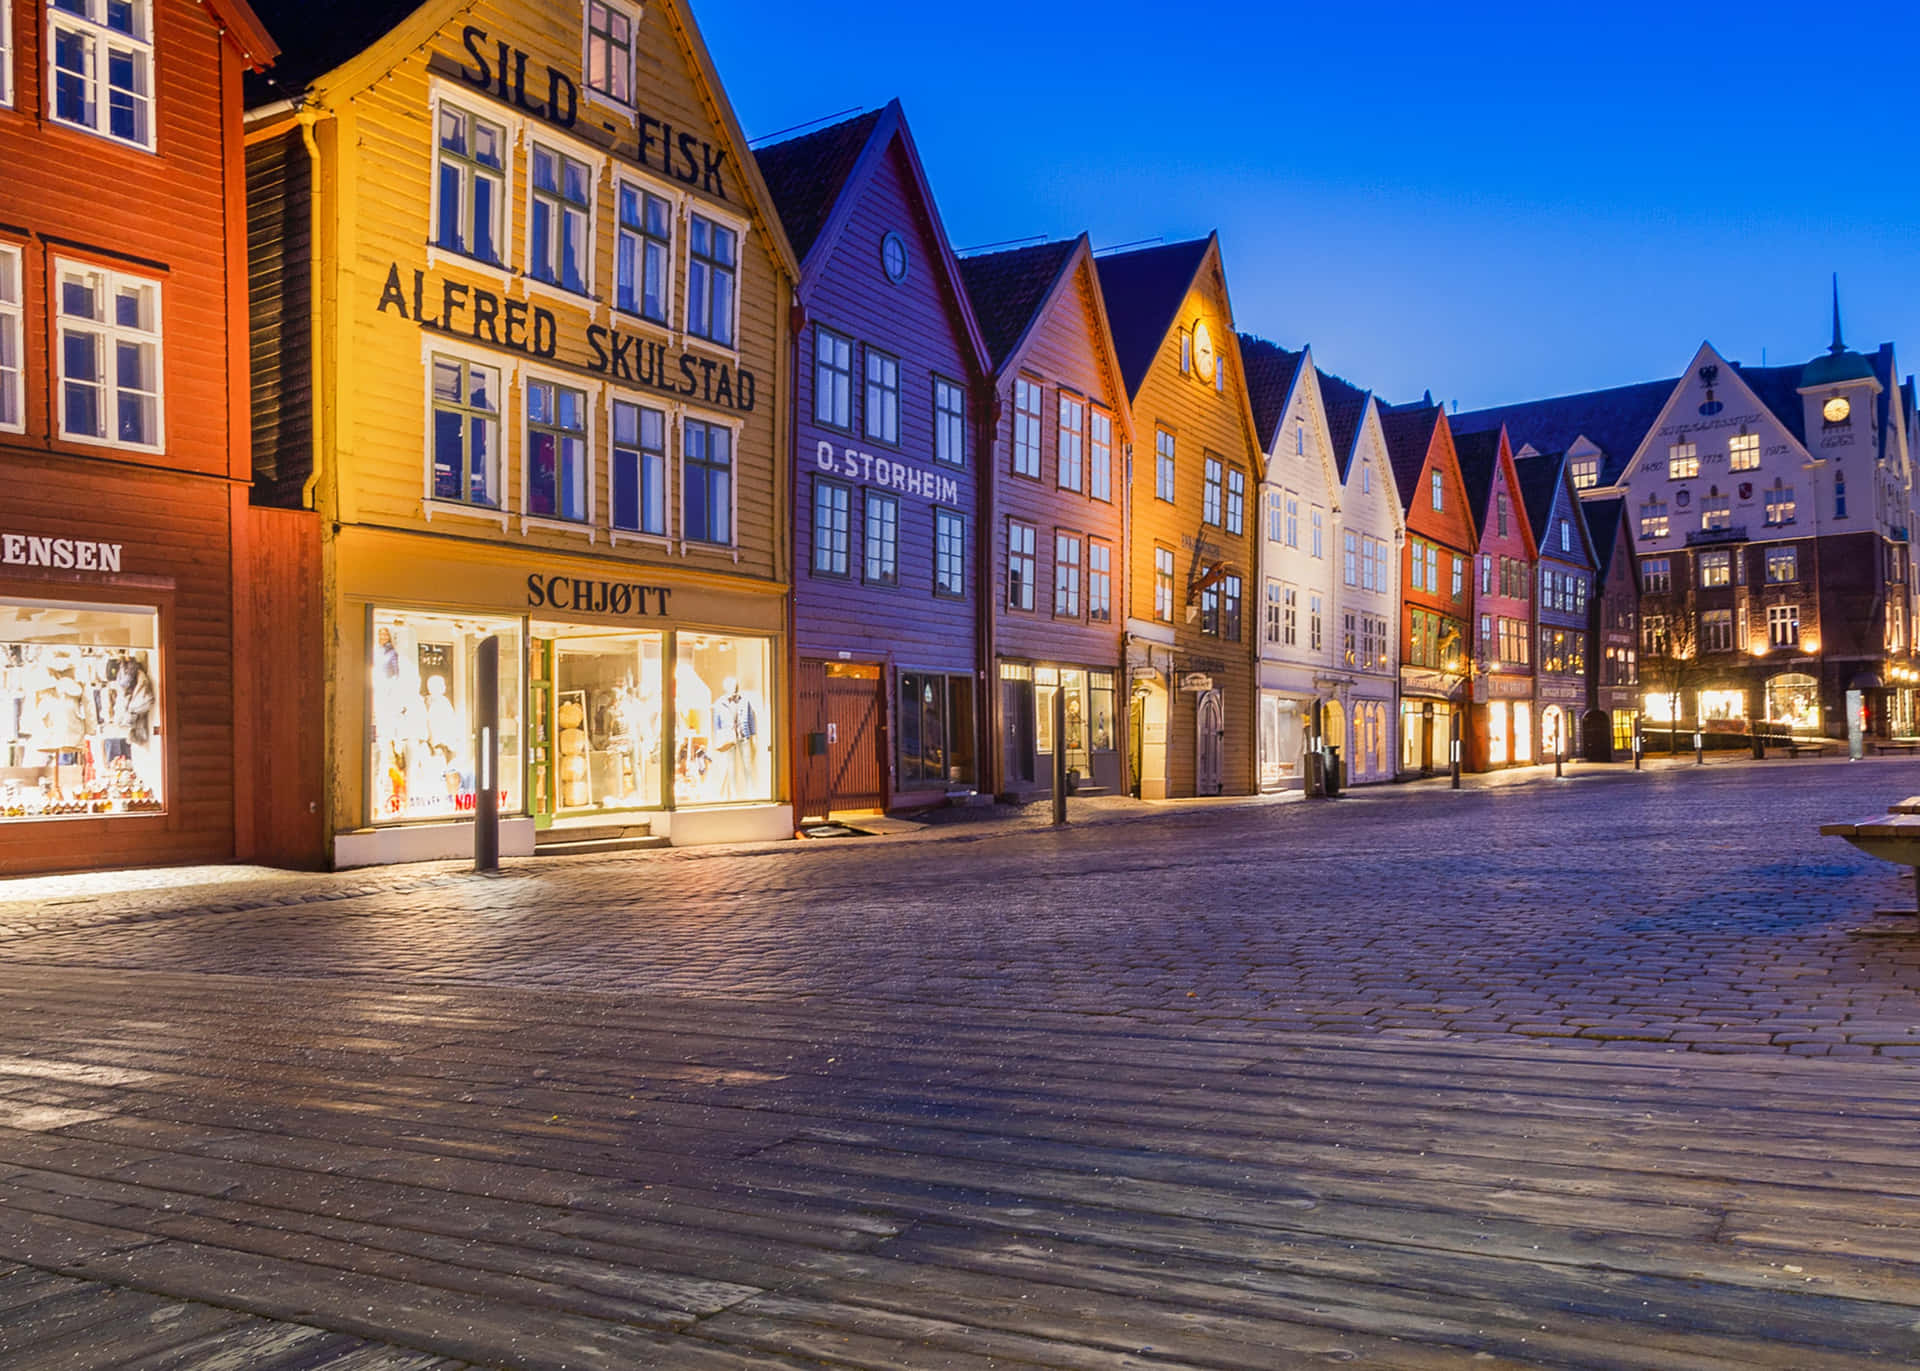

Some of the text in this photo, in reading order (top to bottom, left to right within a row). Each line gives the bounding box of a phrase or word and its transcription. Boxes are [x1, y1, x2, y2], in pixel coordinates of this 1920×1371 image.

[461, 25, 578, 130] SILD
[638, 113, 728, 200] FISK
[377, 262, 755, 412] ALFRED SKULSTAD
[845, 449, 957, 505] STORHEIM
[2, 533, 122, 572] ENSEN
[527, 573, 672, 617] SCHJØTT
